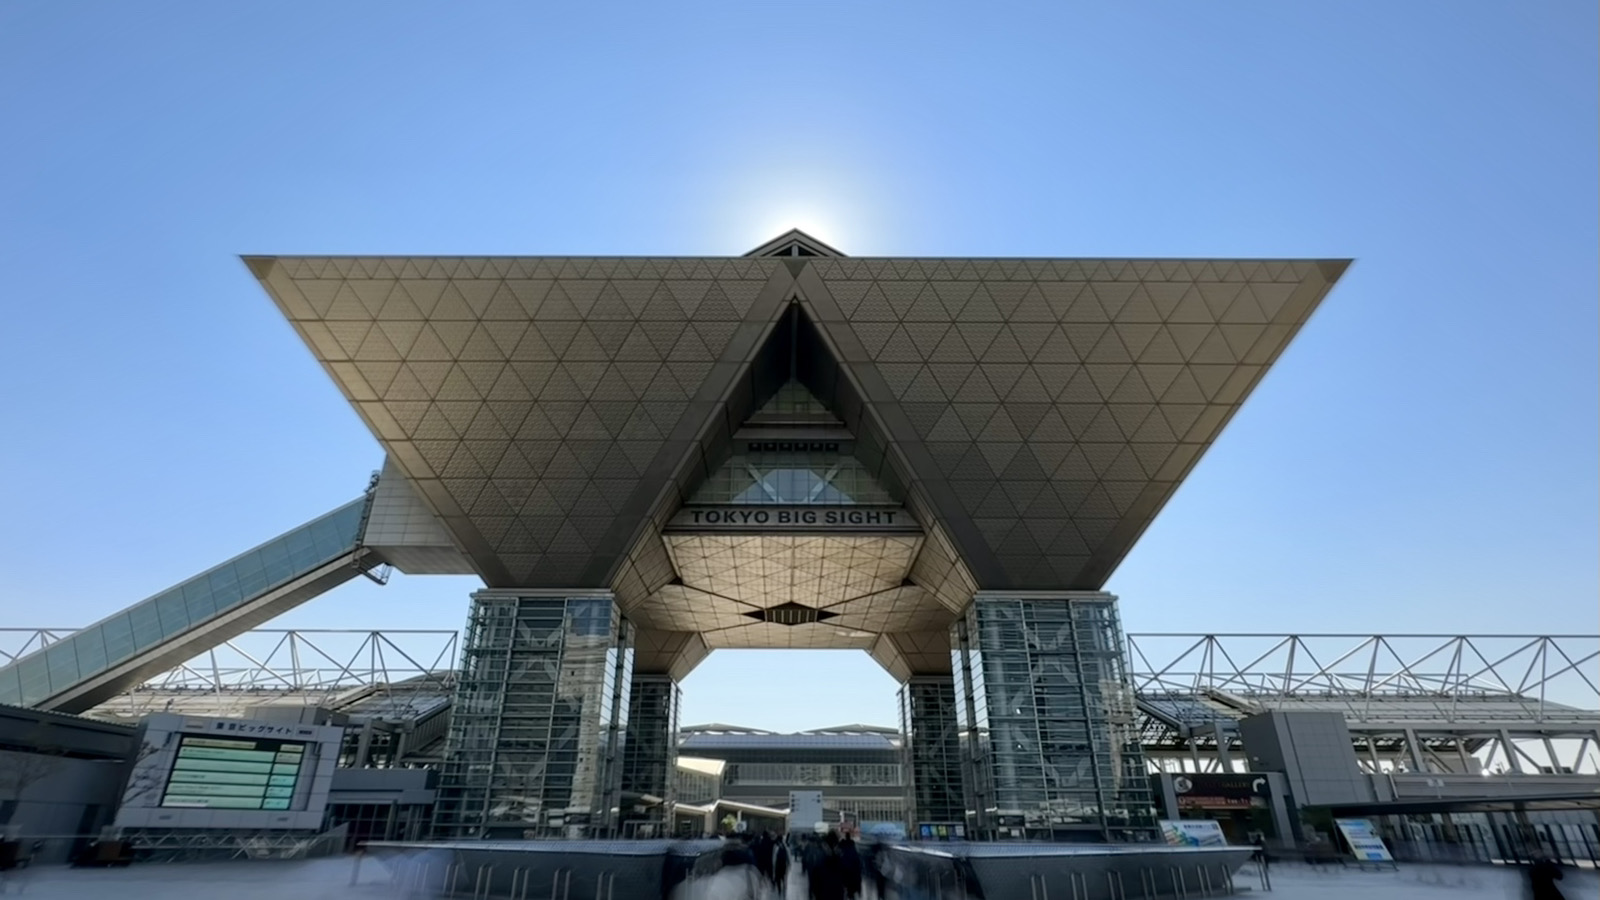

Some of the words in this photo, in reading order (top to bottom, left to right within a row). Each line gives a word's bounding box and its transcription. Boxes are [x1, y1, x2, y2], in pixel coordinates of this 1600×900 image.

[691, 511, 769, 523] TOKYO
[778, 511, 816, 523] BIG
[825, 511, 897, 523] SIGHT
